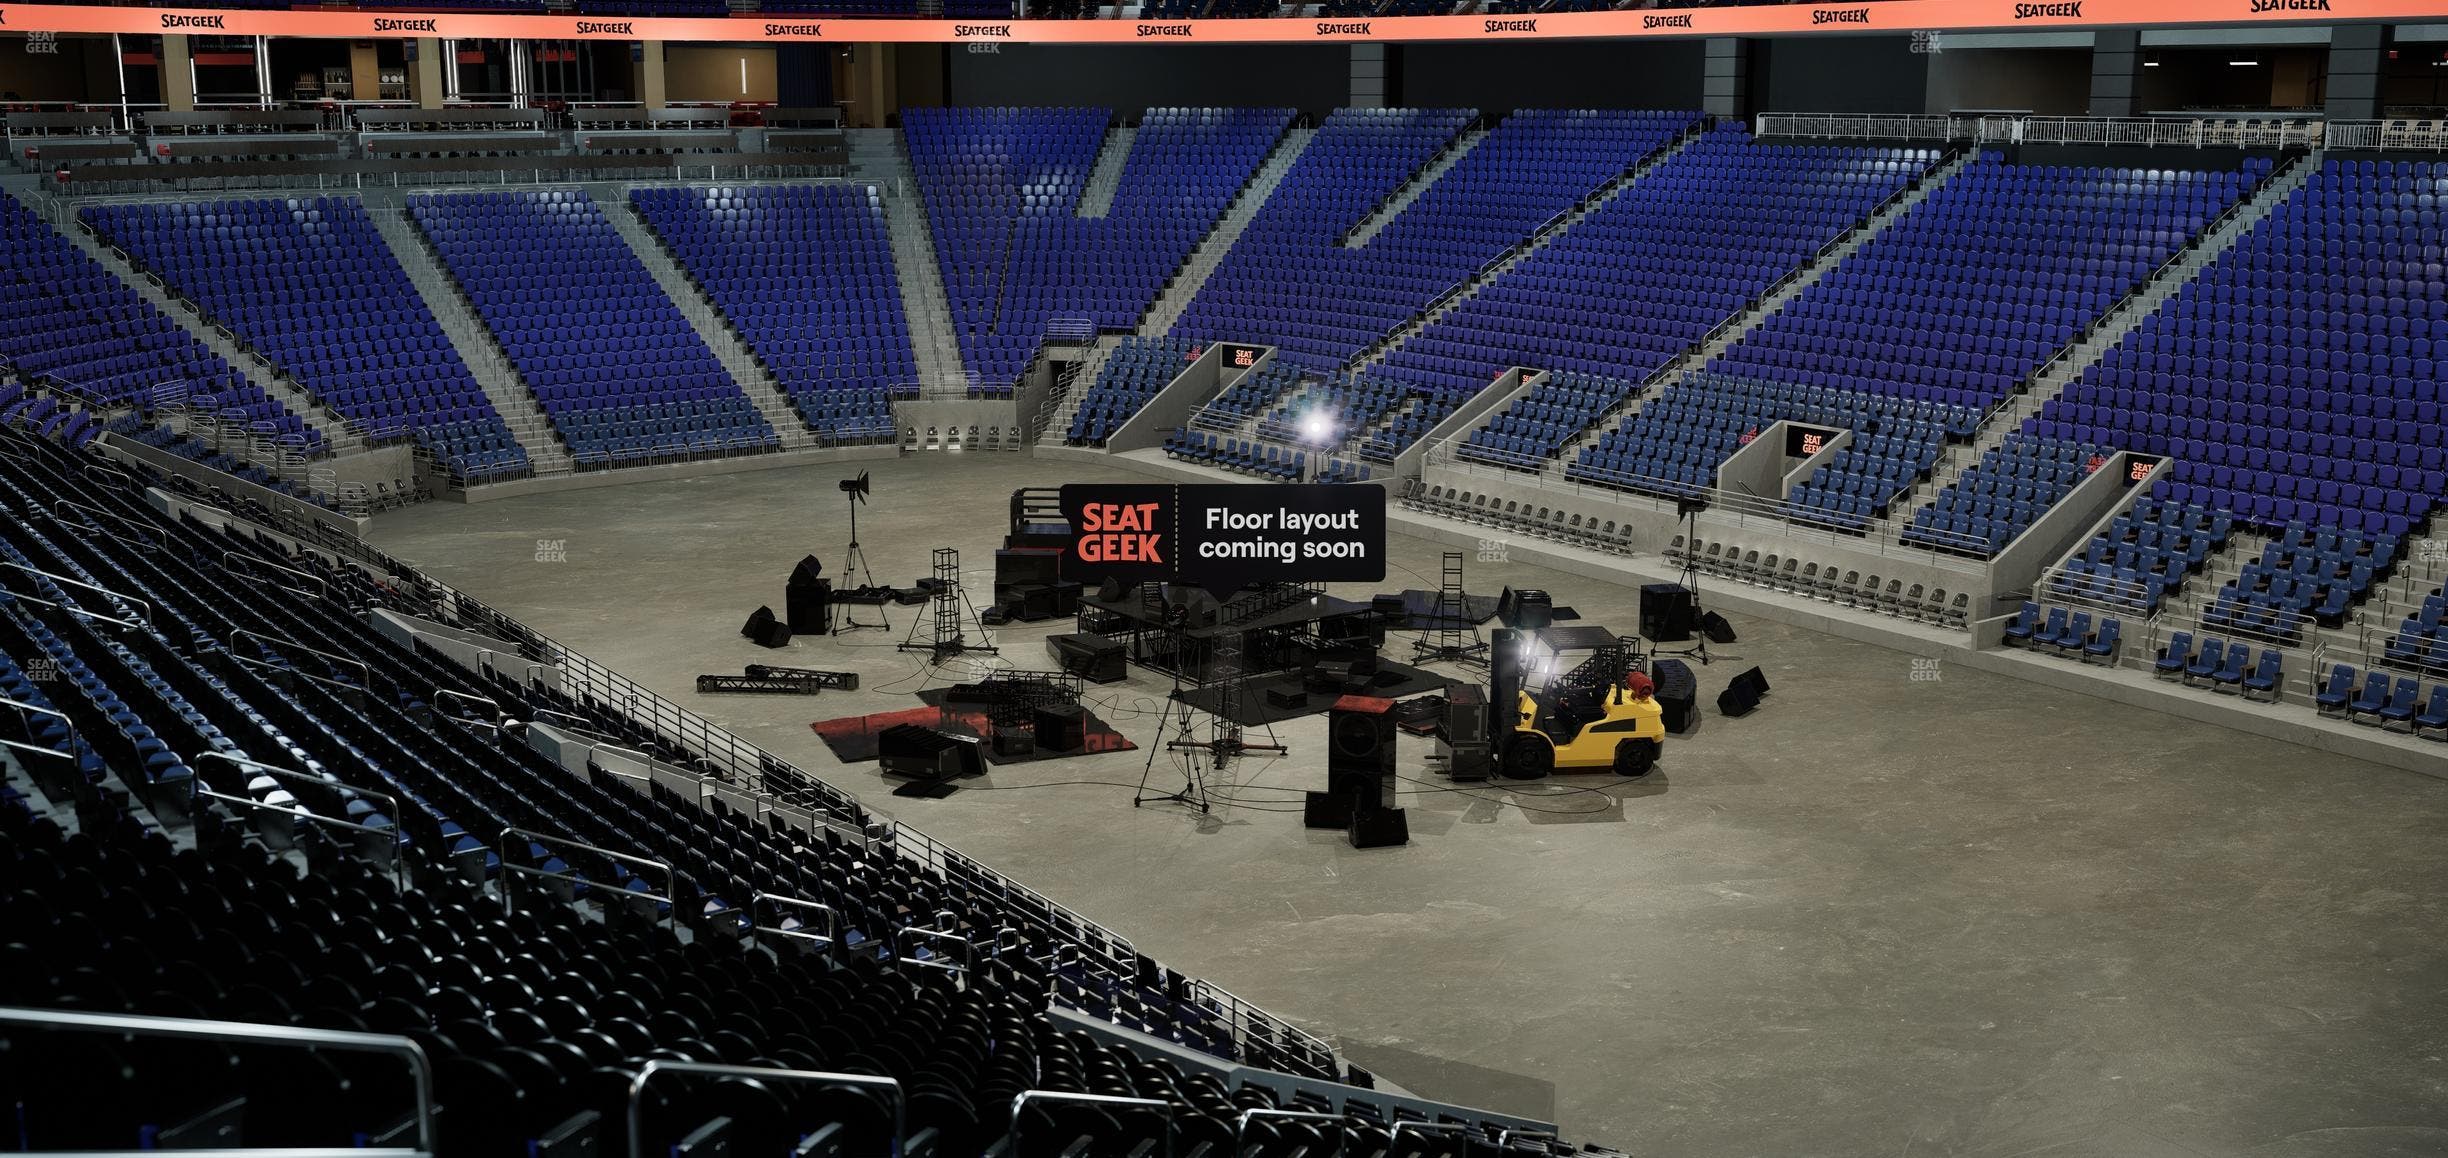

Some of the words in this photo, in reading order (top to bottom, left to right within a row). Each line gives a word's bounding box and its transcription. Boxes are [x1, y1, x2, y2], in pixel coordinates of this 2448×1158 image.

[1812, 8, 1869, 24] SEATGEEK
[2014, 1, 2081, 19] SEATGEEK
[160, 14, 225, 29] SEATGEEK
[373, 18, 437, 32] SEATGEEK
[576, 22, 634, 34] SEATGEEK
[1484, 20, 1537, 33] SEATGEEK
[1643, 14, 1691, 29] SEATGEEK
[764, 24, 822, 37] SEATGEEK
[954, 24, 1011, 37] SEATGEEK
[1136, 24, 1193, 37] SEATGEEK
[1316, 22, 1371, 35] SEATGEEK
[1235, 349, 1253, 358] SEAT
[1803, 433, 1822, 445] SEAT
[2132, 461, 2154, 473] SEAT
